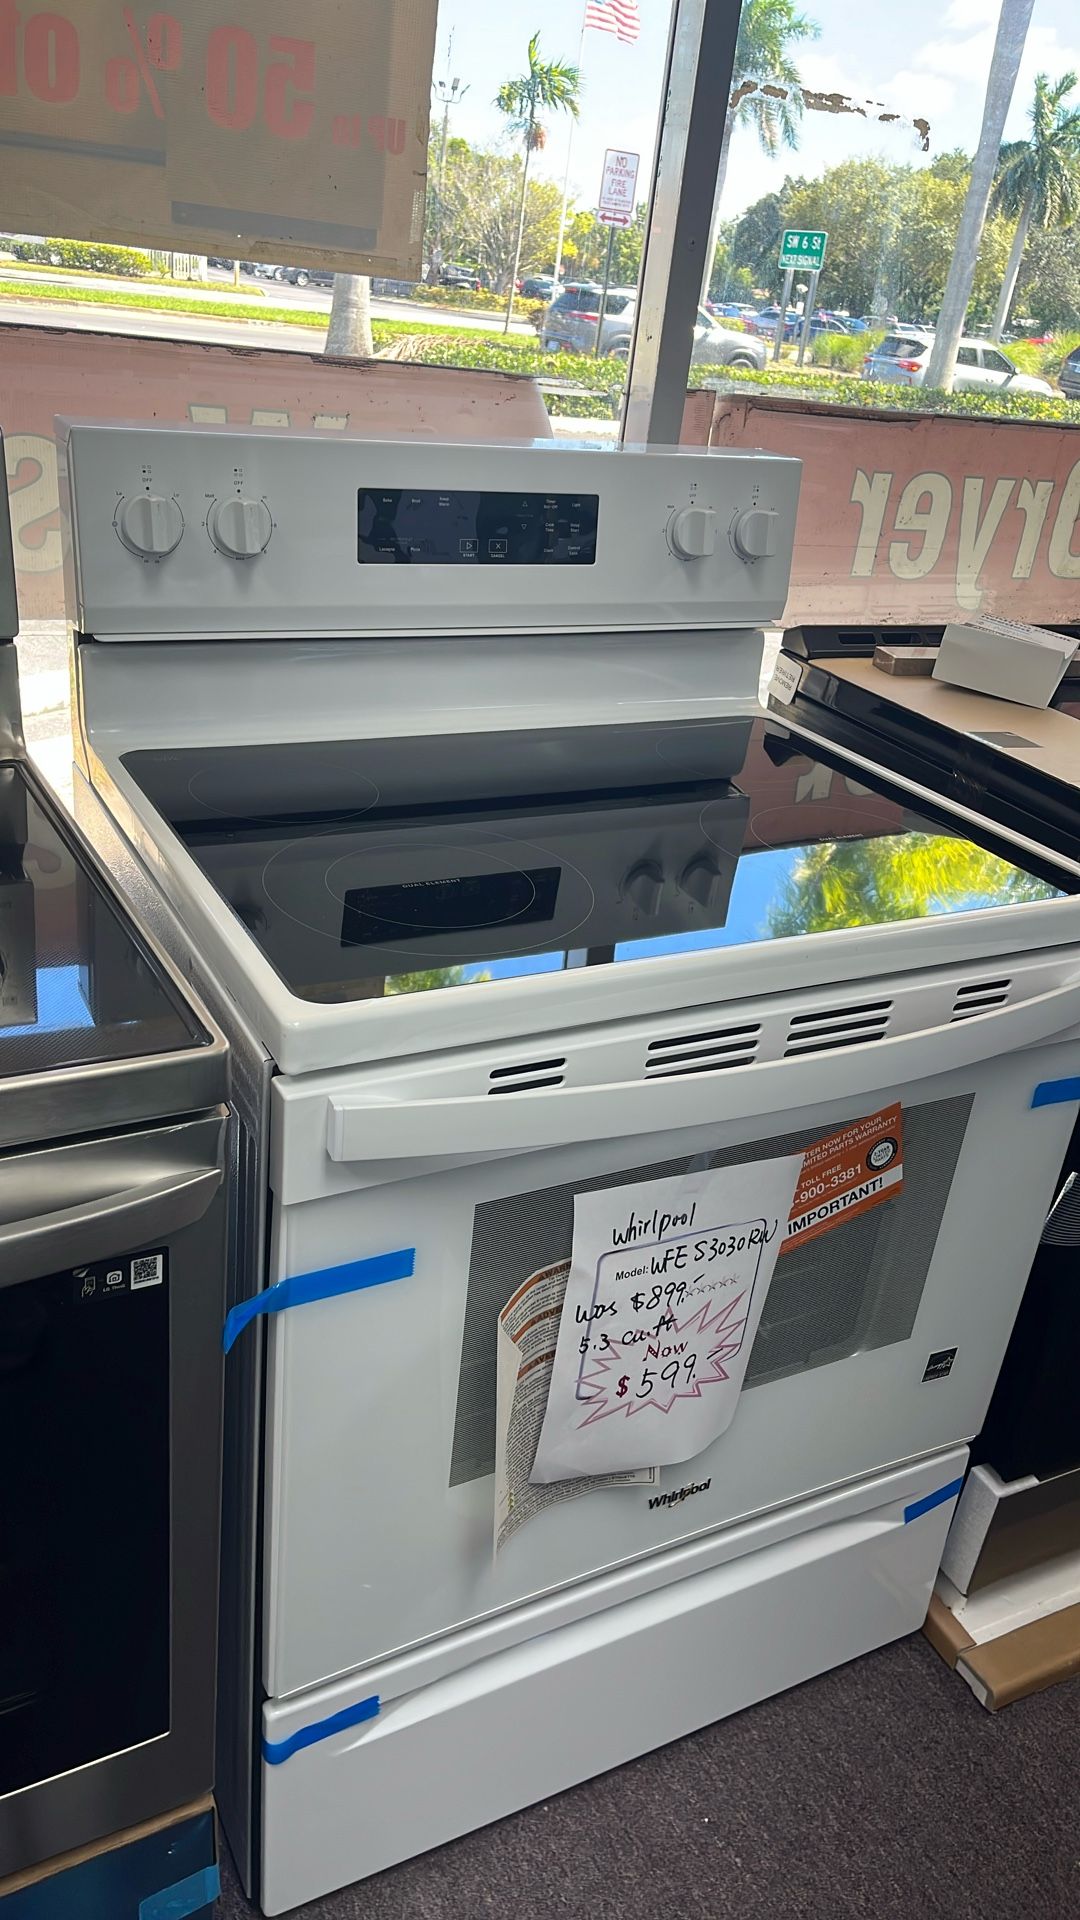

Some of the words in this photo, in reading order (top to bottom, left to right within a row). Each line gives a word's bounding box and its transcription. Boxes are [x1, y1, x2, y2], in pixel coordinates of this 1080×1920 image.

[616, 156, 628, 168] NO
[606, 166, 635, 179] PARKING
[608, 187, 627, 197] LANE
[611, 179, 626, 188] FIRE
[787, 235, 800, 248] SW
[801, 236, 808, 249] 6
[782, 254, 797, 264] NEXT
[797, 255, 821, 266] SIGNAL
[425, 878, 460, 886] ELEMENT
[803, 1152, 828, 1167] MITED
[829, 1138, 854, 1153] PARTS
[855, 1116, 897, 1141] WARRANTY
[822, 1136, 841, 1150] NOW
[842, 1127, 859, 1141] FOR
[860, 1116, 882, 1131] YOUR
[793, 1164, 862, 1204] -900-3381
[800, 1176, 821, 1188] TOLL
[822, 1164, 842, 1178] FREE
[788, 1177, 884, 1235] IMPORTANT!
[615, 1265, 648, 1281] Model:
[579, 1333, 611, 1354] 5.3
[642, 1340, 689, 1362] Now
[648, 1478, 712, 1510] Whirlpool
